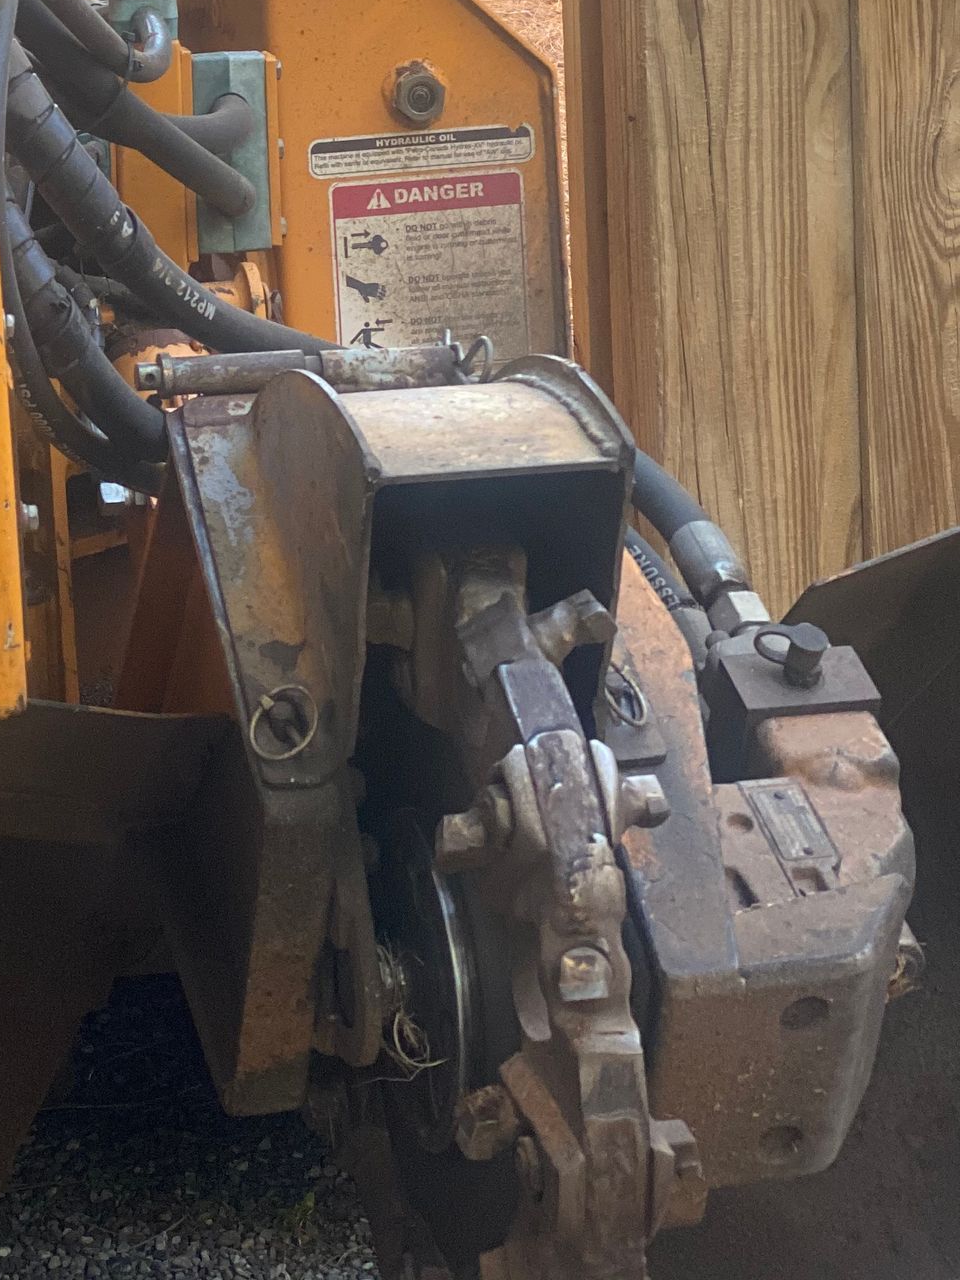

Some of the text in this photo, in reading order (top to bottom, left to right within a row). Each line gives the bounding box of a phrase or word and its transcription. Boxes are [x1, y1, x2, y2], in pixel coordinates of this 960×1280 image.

[376, 133, 456, 147] HYDRAULIC OIL
[394, 182, 484, 204] DANGER
[405, 224, 418, 233] DO
[419, 222, 437, 232] NOT
[408, 275, 420, 284] DO
[421, 273, 440, 283] NOT
[176, 280, 216, 321] MP212
